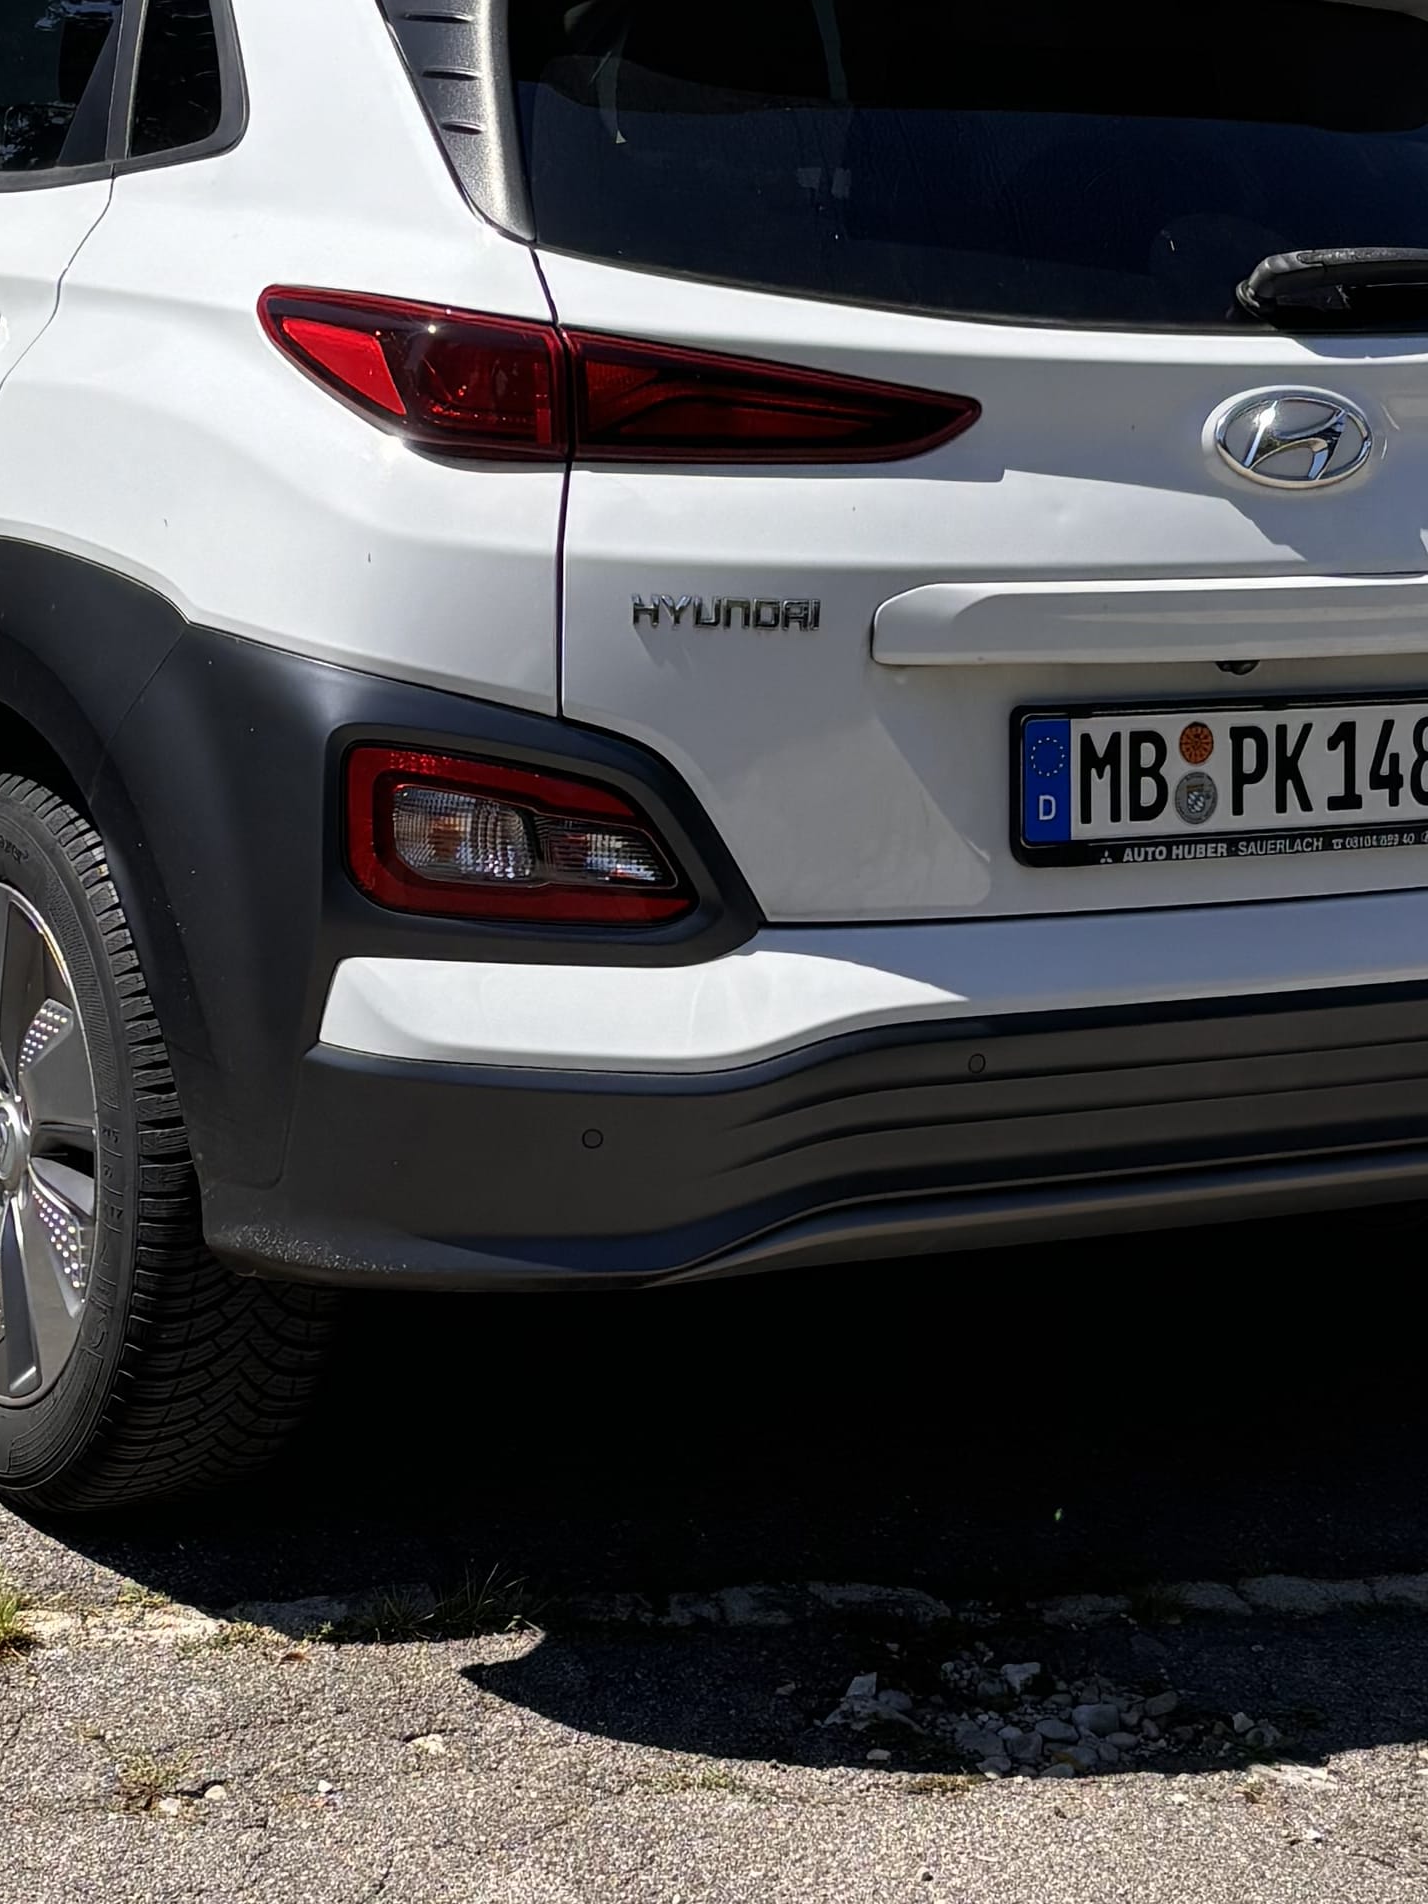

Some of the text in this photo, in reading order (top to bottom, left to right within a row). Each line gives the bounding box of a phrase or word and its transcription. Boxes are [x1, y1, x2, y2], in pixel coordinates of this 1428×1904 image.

[630, 593, 822, 632] HYUNDAI
[1079, 729, 1169, 825] MB
[1038, 794, 1057, 822] D
[1122, 845, 1167, 863] AUTO
[1172, 842, 1228, 860] HUBER
[1238, 837, 1324, 856] SAUERLACH
